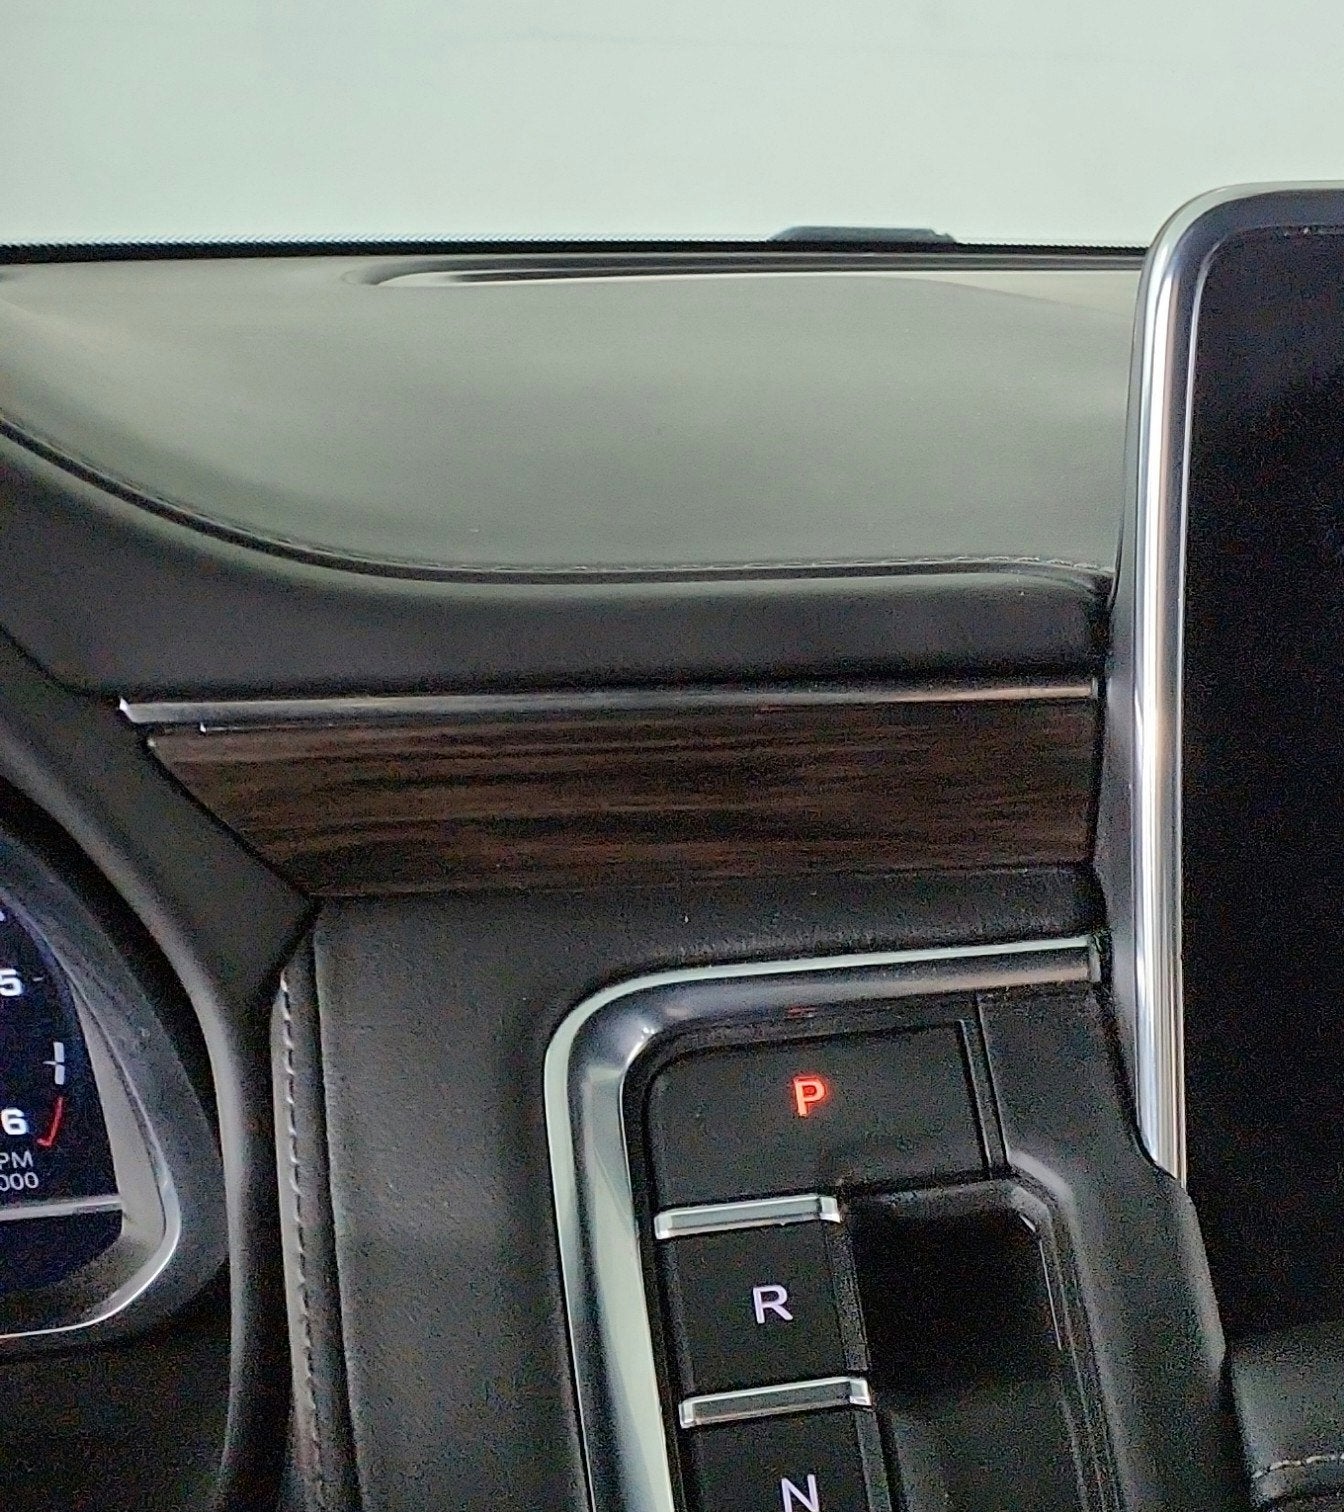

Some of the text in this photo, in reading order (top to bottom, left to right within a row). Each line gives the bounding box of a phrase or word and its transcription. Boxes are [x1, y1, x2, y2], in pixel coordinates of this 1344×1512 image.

[793, 1075, 828, 1117] P
[0, 1107, 28, 1136] 6
[752, 1284, 794, 1324] R
